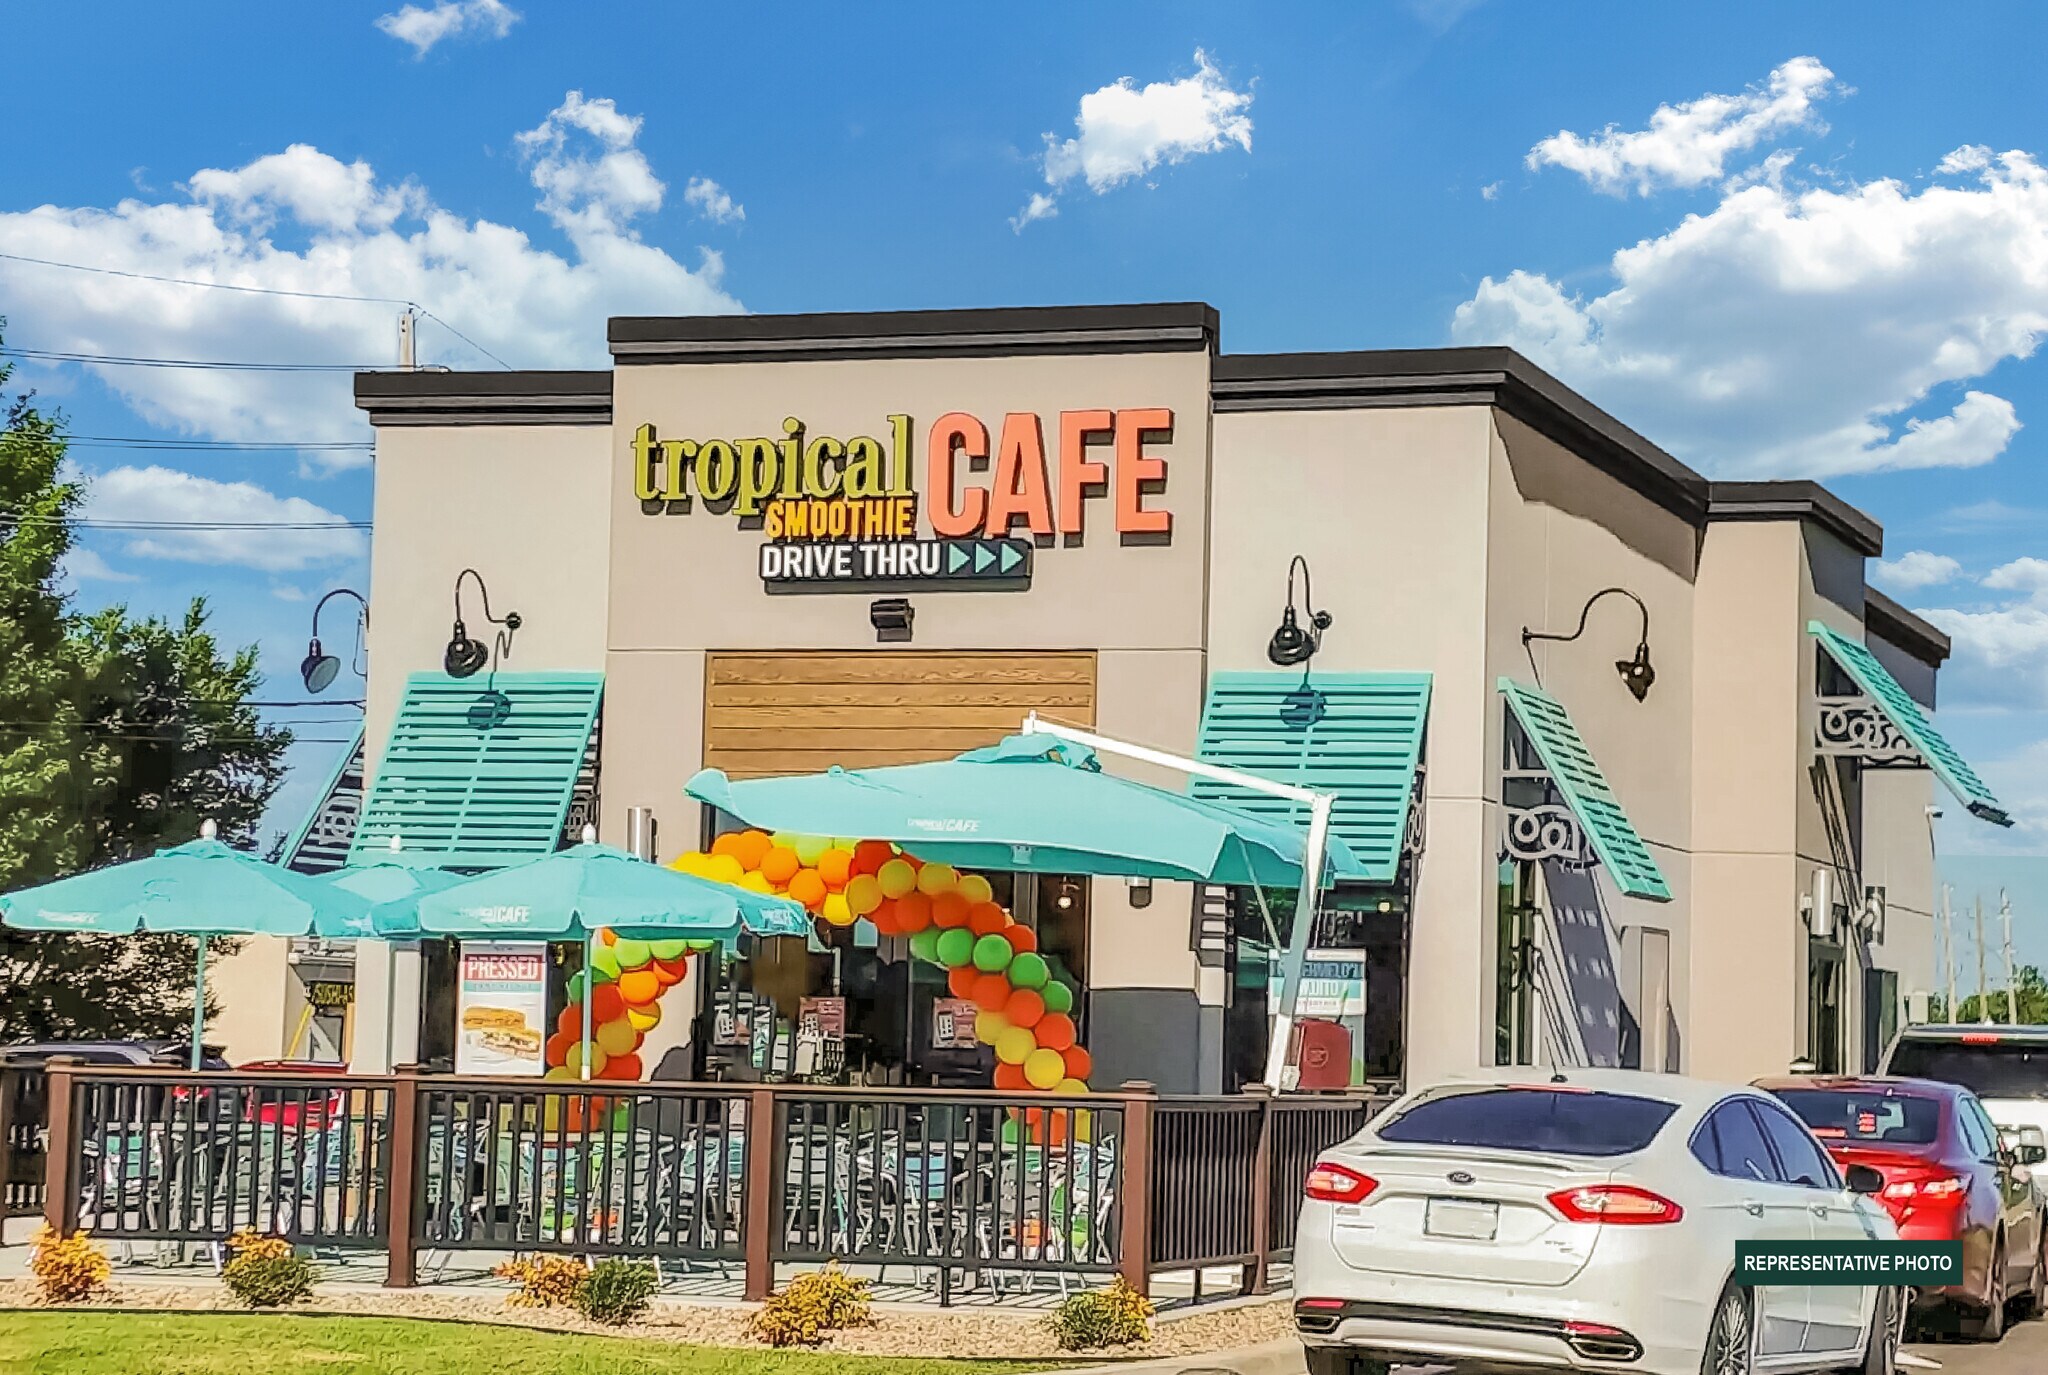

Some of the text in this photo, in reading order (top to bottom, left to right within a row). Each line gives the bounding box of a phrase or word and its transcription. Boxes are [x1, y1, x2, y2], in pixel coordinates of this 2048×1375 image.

[630, 408, 1172, 537] tropical CAFE
[766, 499, 914, 538] SMOOTHIE
[761, 542, 941, 578] DRIVE THRU
[497, 905, 529, 923] CAFE
[466, 955, 539, 980] PRESSED
